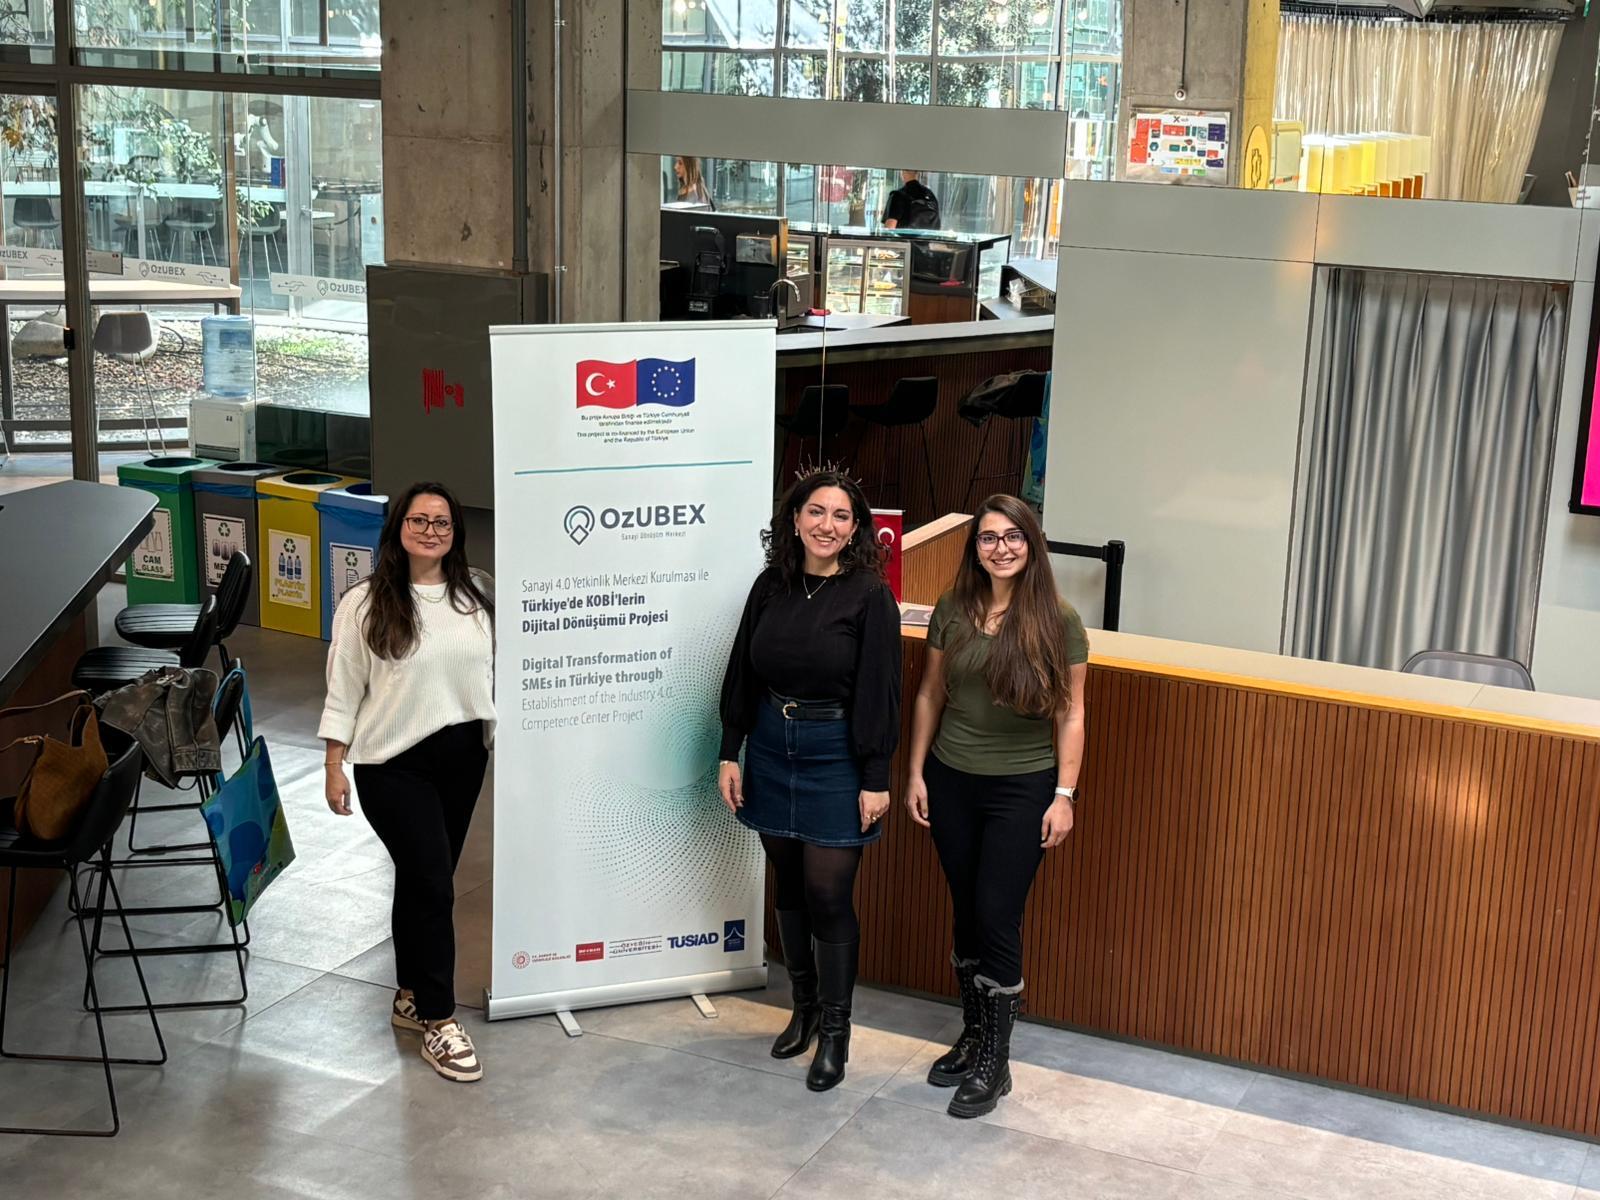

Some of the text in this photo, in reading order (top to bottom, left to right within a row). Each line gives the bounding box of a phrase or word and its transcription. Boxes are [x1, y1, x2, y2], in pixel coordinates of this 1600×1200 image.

[0, 250, 28, 259] zUBEX
[150, 264, 186, 276] OzUBEX
[330, 282, 367, 294] OzUBEX
[600, 504, 706, 530] OzUBEX
[142, 564, 164, 574] GLASS
[143, 554, 161, 564] CAM
[522, 568, 710, 594] Sanayi 4.0 Yetkinlik Merkezi Kurulması ile
[522, 592, 646, 614] Türkiye'de KOBİ'lerin
[522, 610, 668, 635] Dijital Dönüşümü Projesi
[522, 647, 672, 674] Digital Transformation of
[522, 667, 663, 691] SMEs in Türkiye through
[522, 694, 587, 711] Establishment
[589, 690, 600, 704] of
[600, 690, 616, 704] the
[618, 686, 656, 704] Industry
[522, 709, 644, 732] Competence Center Project
